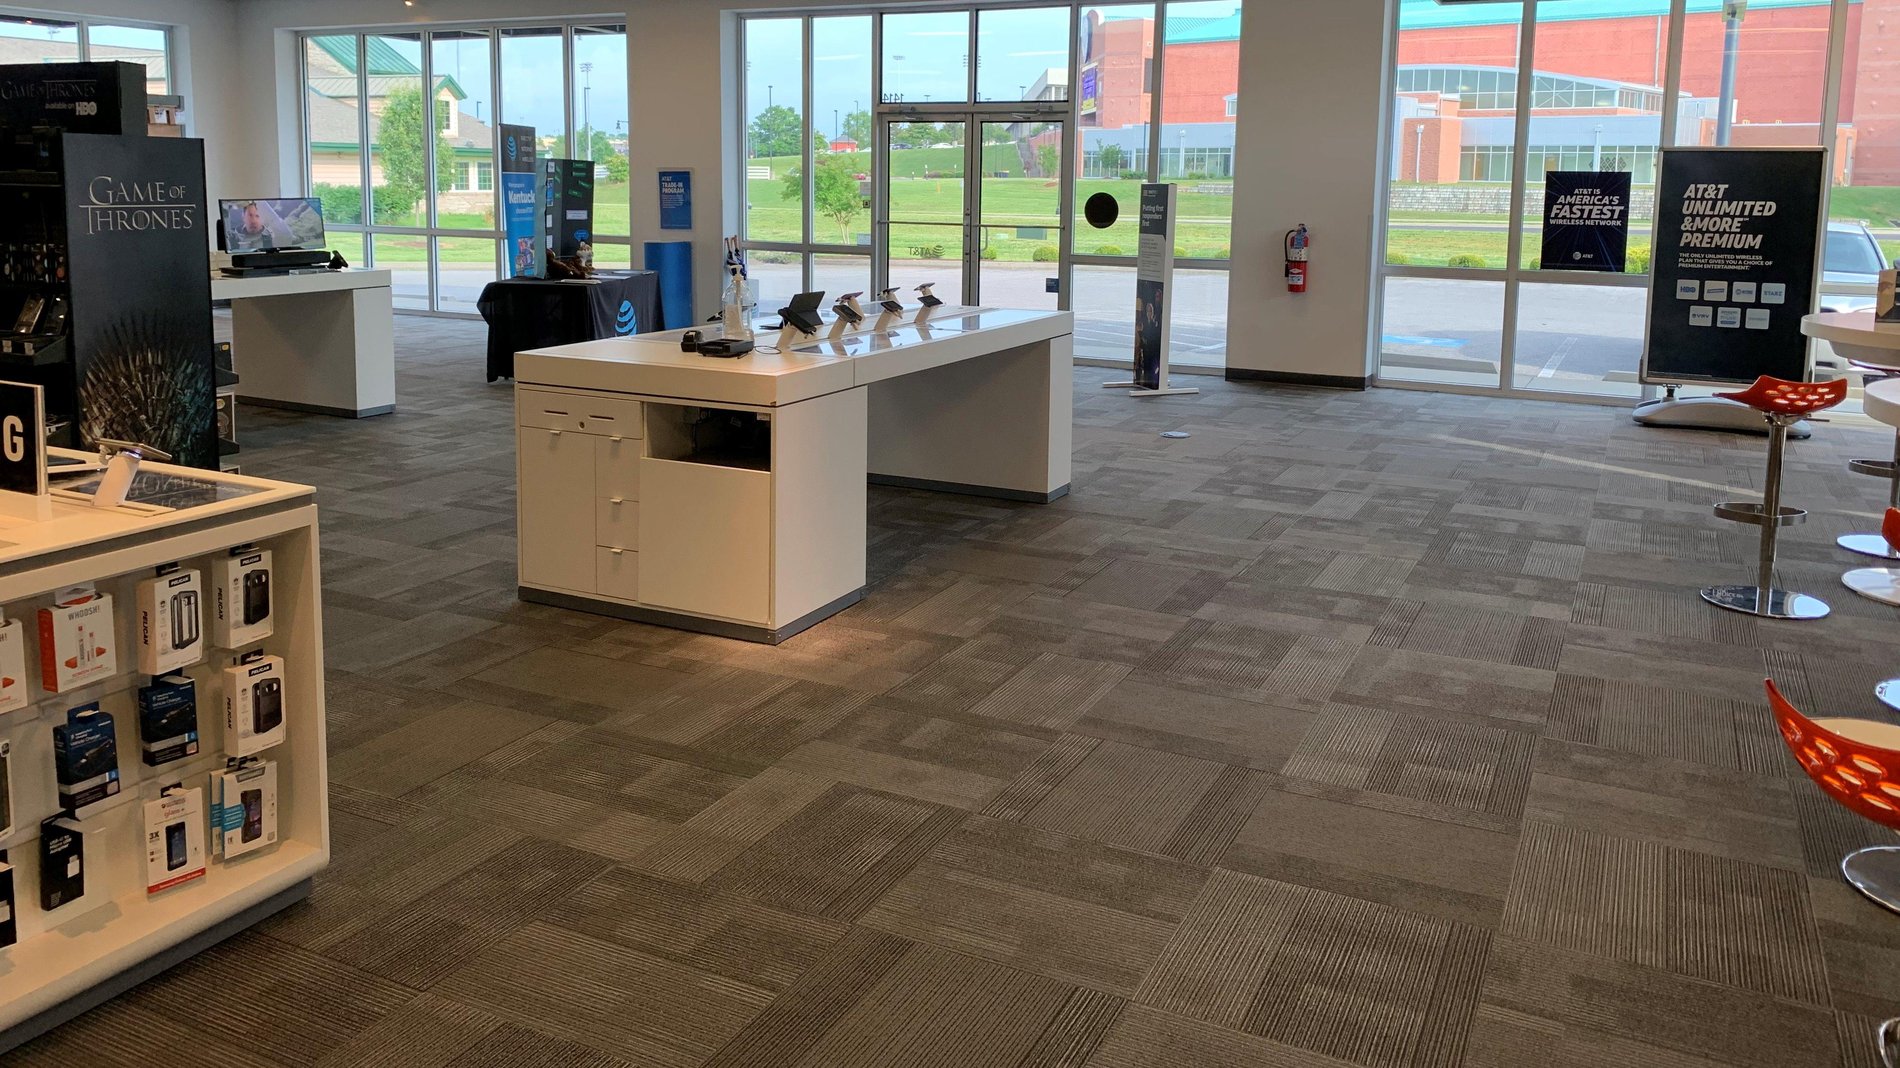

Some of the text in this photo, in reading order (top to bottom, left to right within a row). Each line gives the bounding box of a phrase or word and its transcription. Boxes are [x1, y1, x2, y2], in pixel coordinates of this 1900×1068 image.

[75, 101, 97, 115] HBO
[89, 175, 186, 206] GAME OF
[508, 190, 536, 204] Kentuck
[1683, 184, 1729, 199] AT&T
[1556, 195, 1620, 205] AMERICA'S
[1550, 204, 1625, 219] FASTEST
[1682, 200, 1777, 217] UNLIMITED
[79, 204, 196, 234] THRONES
[1549, 218, 1584, 226] WIRELESS
[1679, 233, 1763, 250] PREMIUM
[3, 415, 25, 462] G
[68, 605, 100, 621] WHOOSH!
[250, 665, 271, 676] PELICAN
[149, 831, 160, 840] 3X
